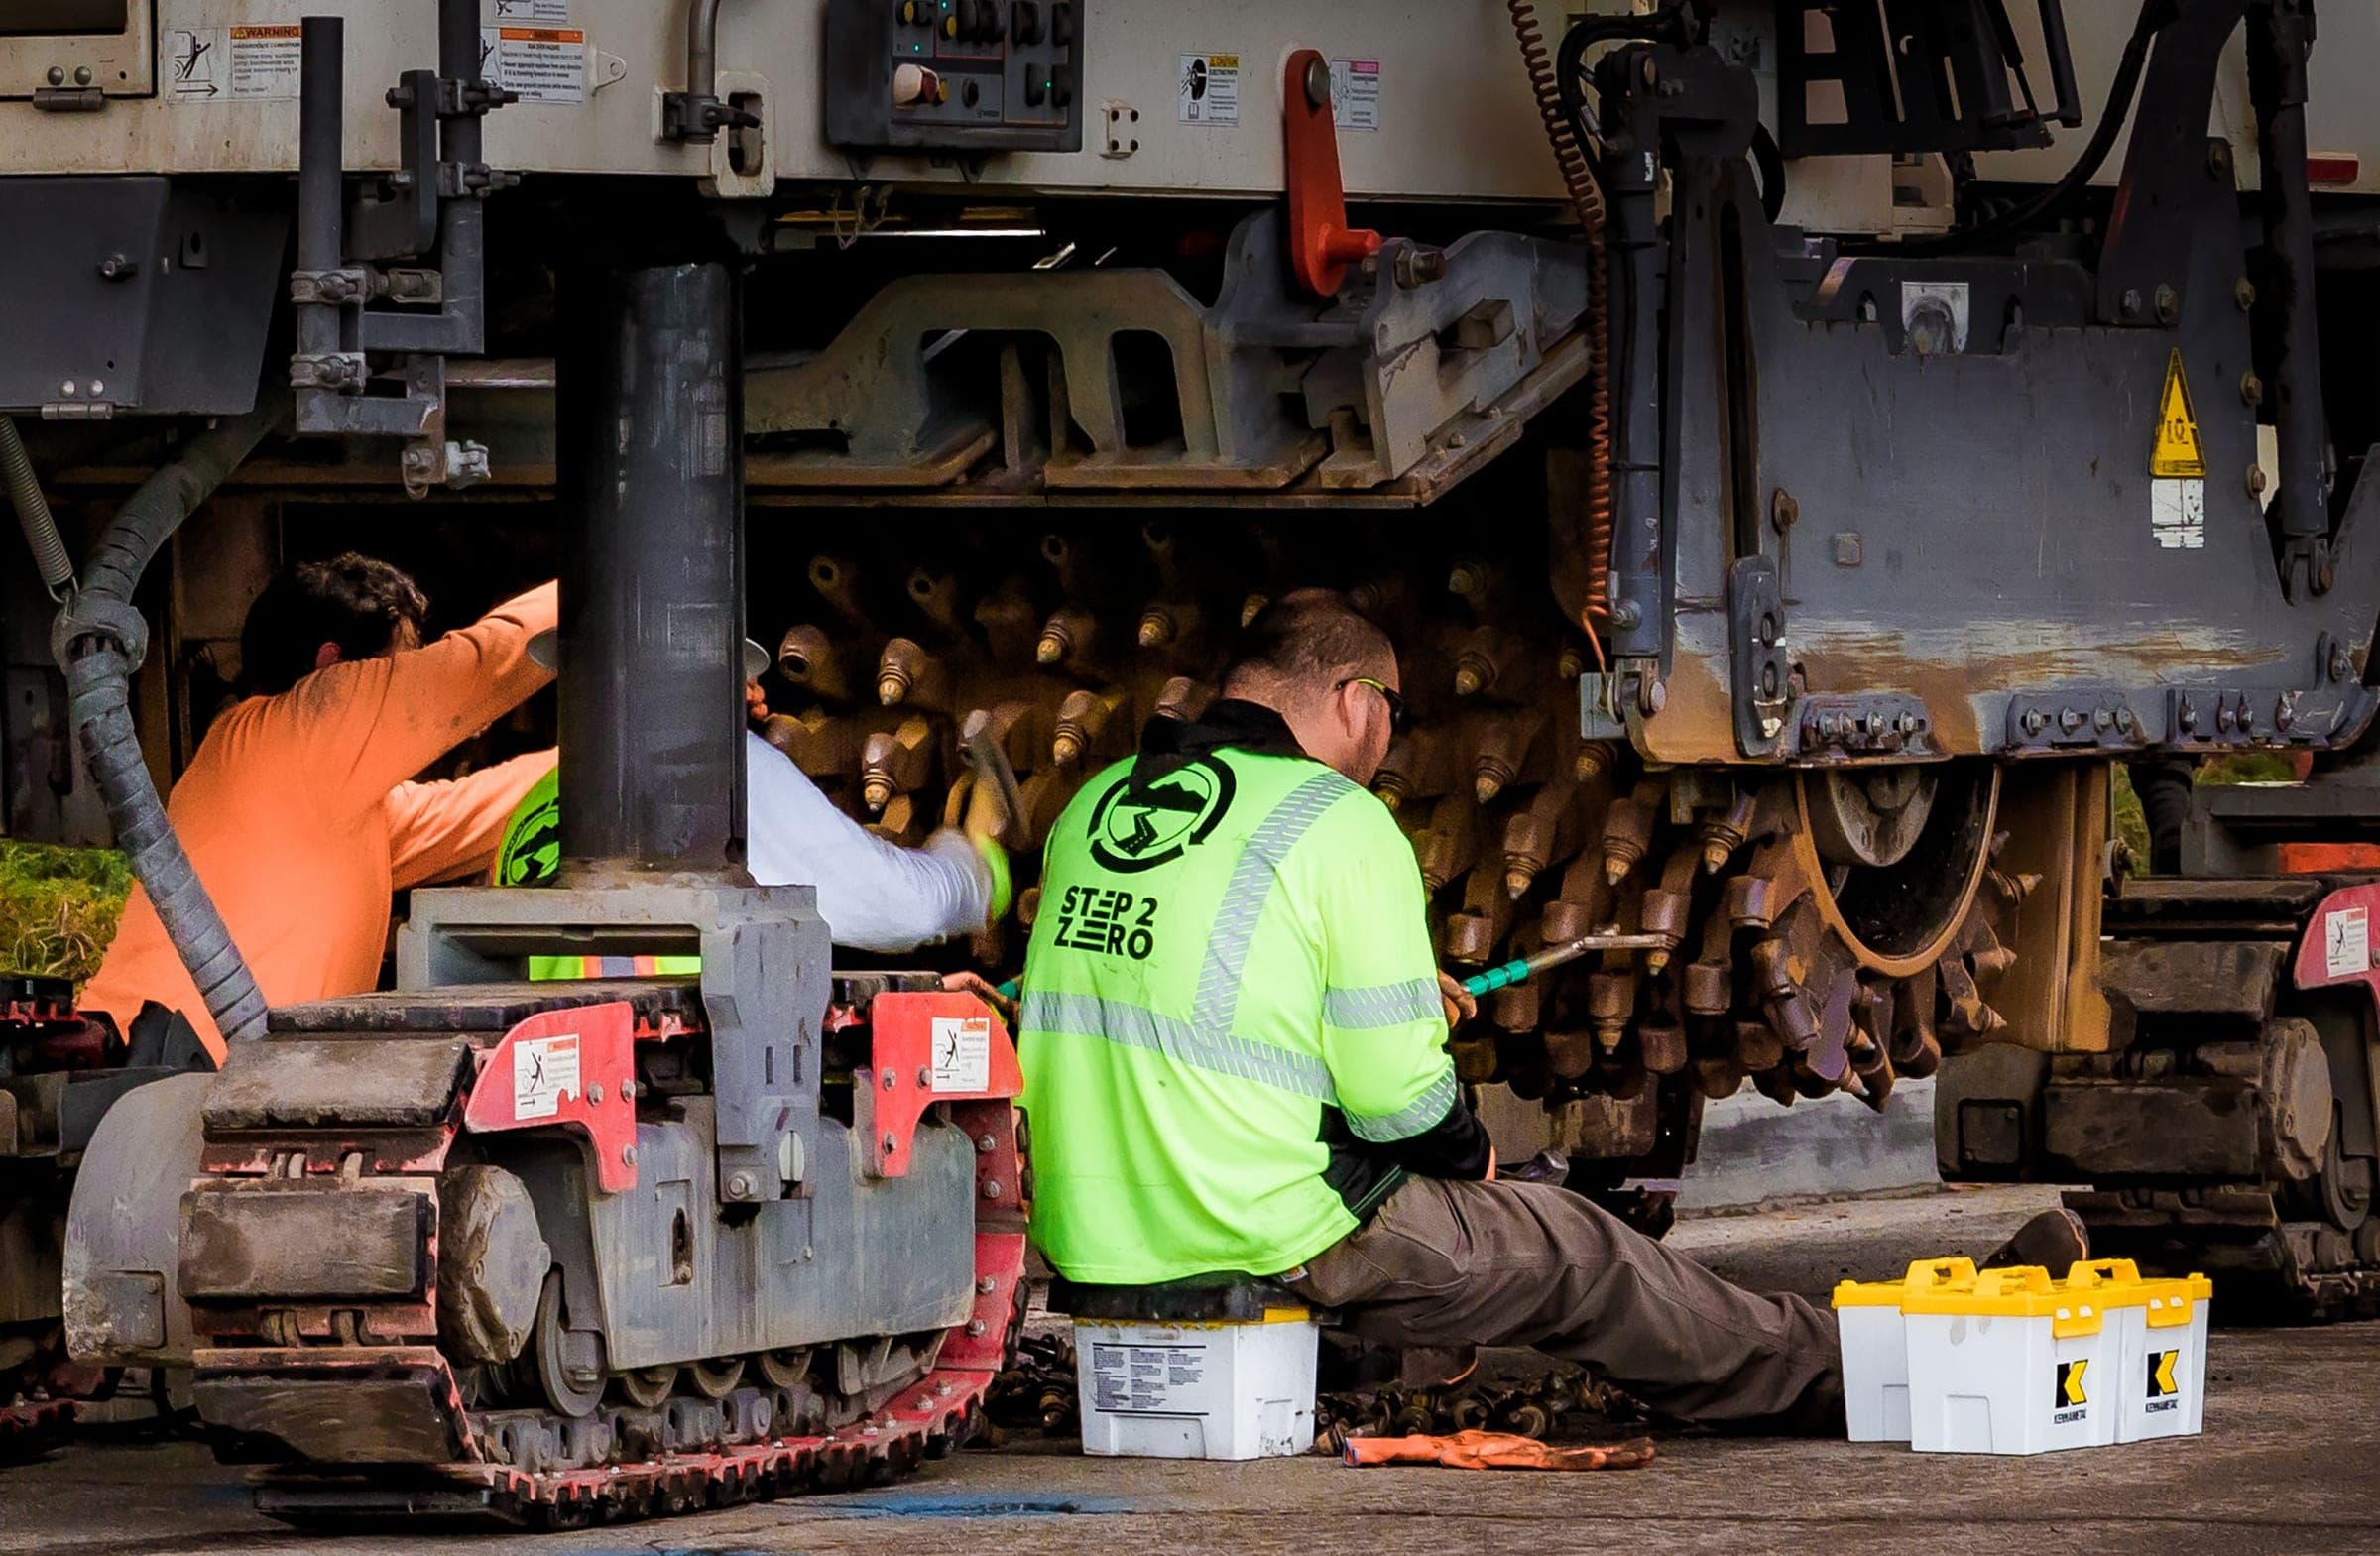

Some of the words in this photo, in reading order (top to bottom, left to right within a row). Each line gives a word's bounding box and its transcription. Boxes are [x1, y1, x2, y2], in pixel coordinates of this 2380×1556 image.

[245, 27, 299, 38] WARNING
[1061, 885, 1133, 921] STEP
[1135, 897, 1158, 927] 2
[1054, 916, 1153, 960] ZERO
